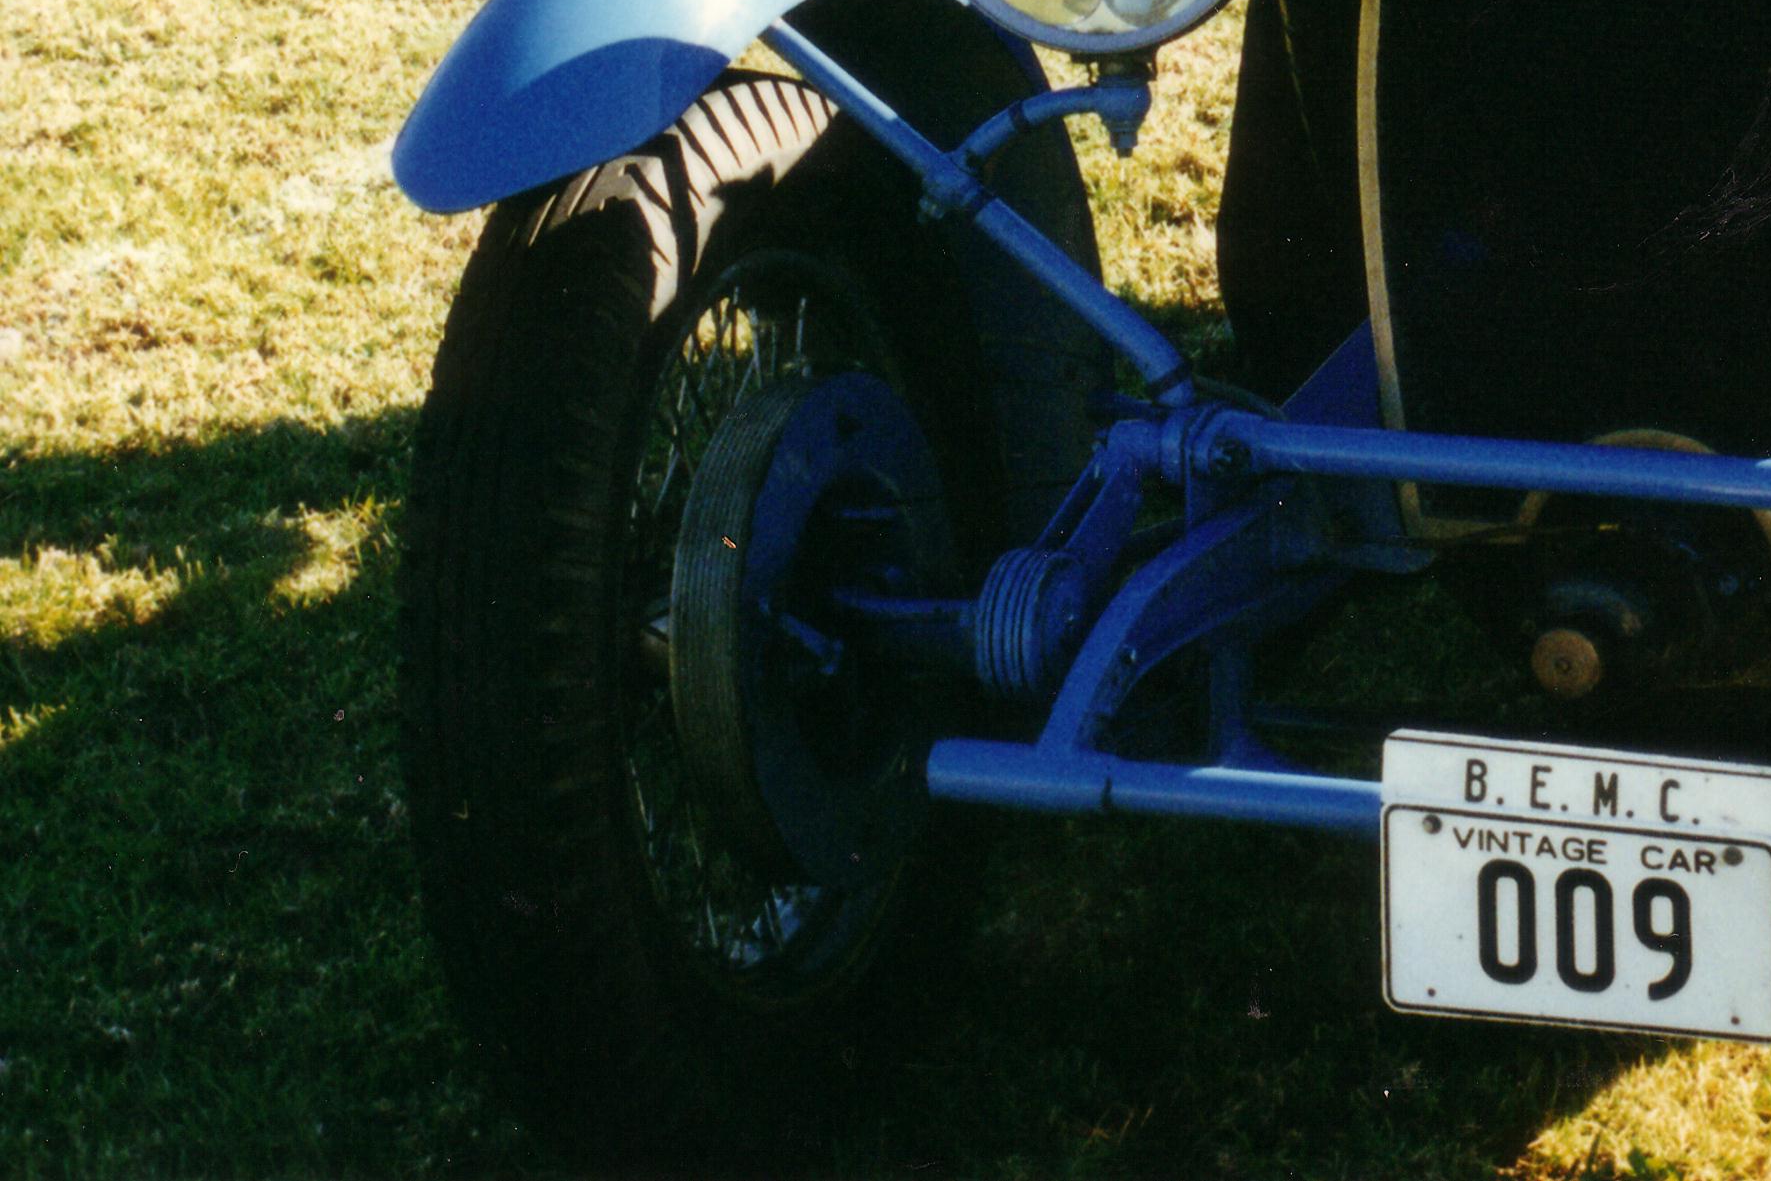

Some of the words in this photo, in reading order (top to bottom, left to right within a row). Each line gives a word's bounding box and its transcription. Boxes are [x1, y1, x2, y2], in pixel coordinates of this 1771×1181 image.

[1452, 826, 1608, 865] VINTAGE
[1640, 845, 1718, 875] CAR
[1477, 857, 1693, 1002] 009
